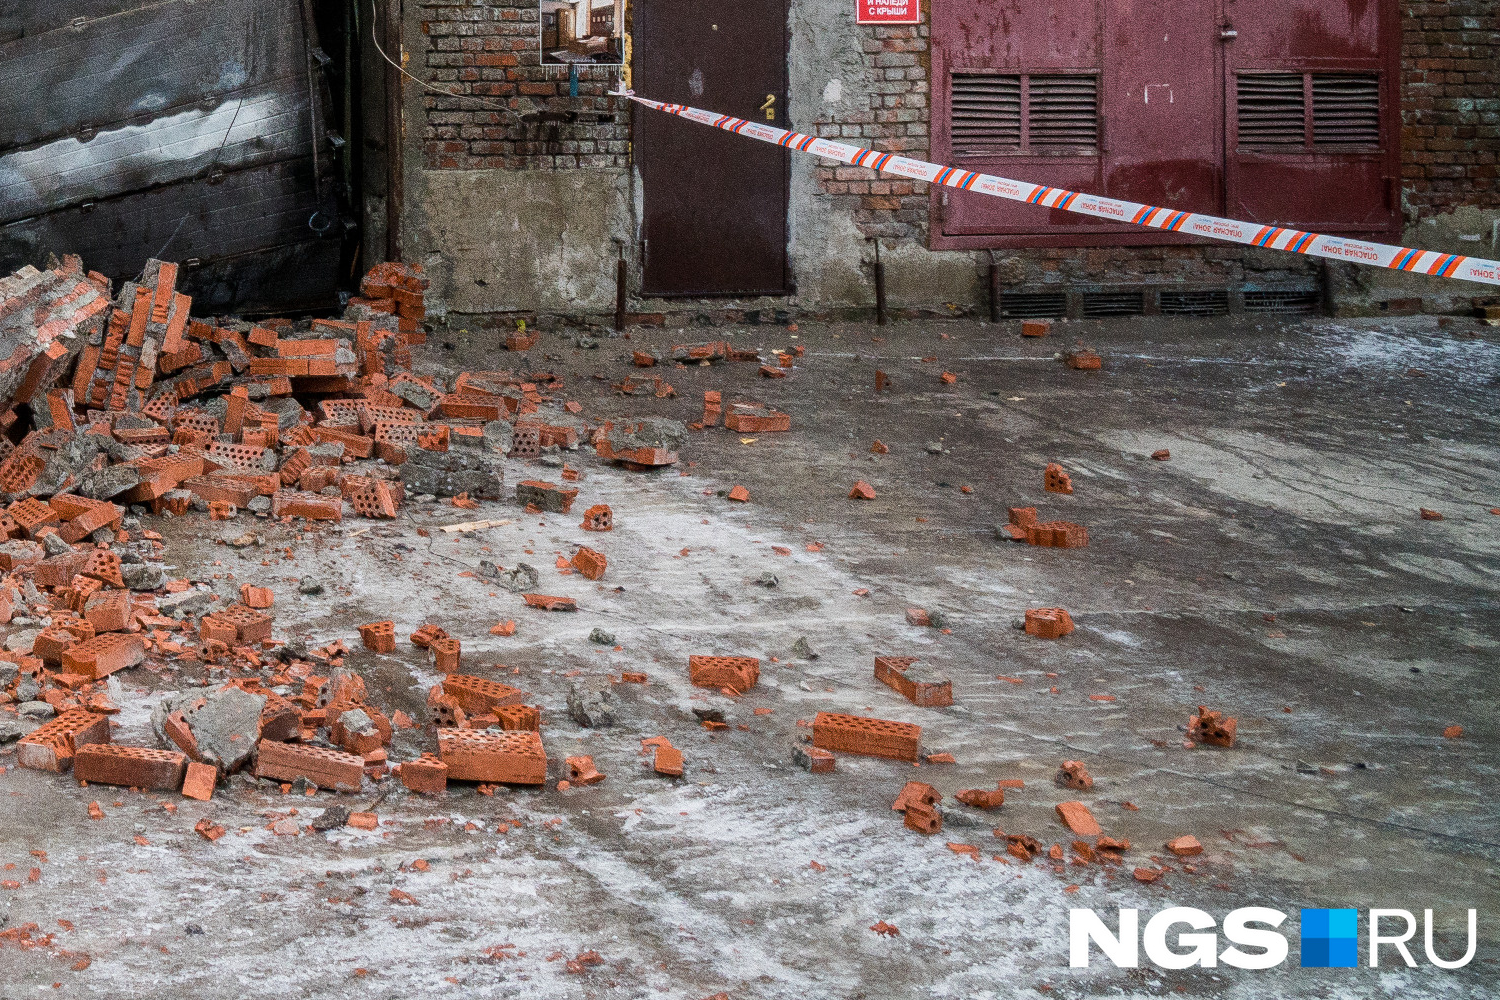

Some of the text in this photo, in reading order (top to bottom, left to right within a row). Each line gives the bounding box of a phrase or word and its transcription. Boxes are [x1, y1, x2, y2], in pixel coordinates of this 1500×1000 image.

[868, 7, 908, 15] С КРЫШИ
[1192, 223, 1243, 238] ОПАСНАЯ ЗОНА!
[1320, 245, 1379, 261] ОПАСНАЯ ЗОНА!
[1469, 268, 1495, 280] ЗОНА!
